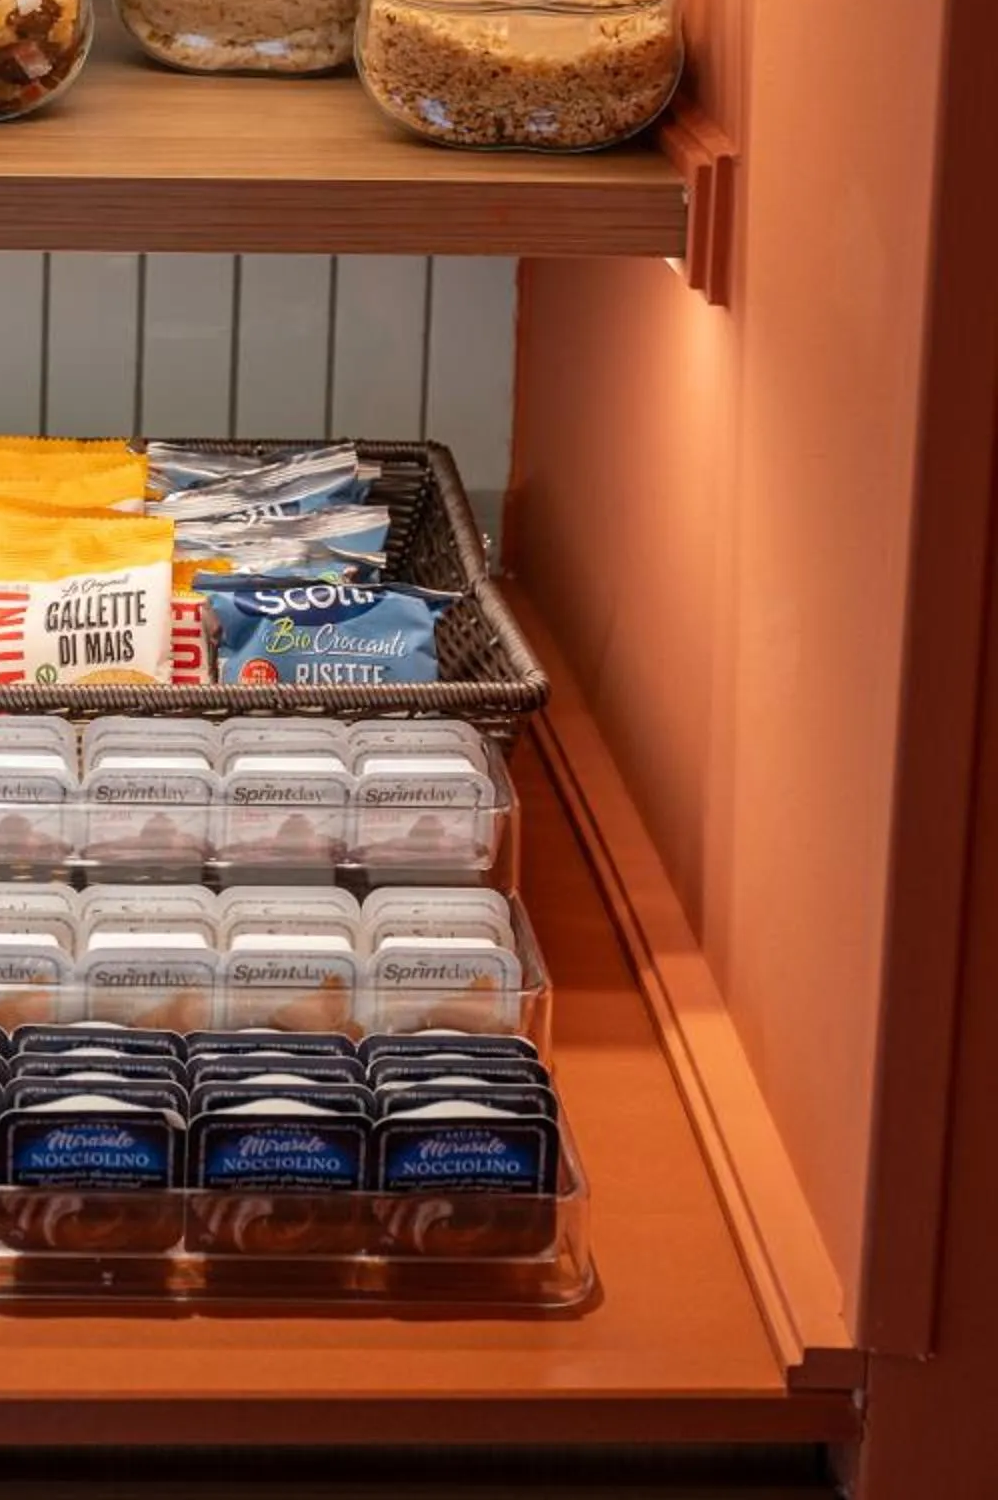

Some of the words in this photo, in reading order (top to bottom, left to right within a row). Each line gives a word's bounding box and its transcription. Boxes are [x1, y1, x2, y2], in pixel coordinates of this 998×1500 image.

[45, 590, 148, 632] GALLETTE
[266, 617, 311, 653] Bio
[59, 634, 77, 667] DI
[85, 629, 135, 666] MAIS
[295, 662, 386, 685] RISETTE
[45, 1129, 136, 1151] Mirasole
[238, 1135, 327, 1157] Mirasole
[419, 1137, 507, 1160] Mirasole
[30, 1152, 151, 1168] NOCCIOLINO
[222, 1157, 341, 1173] NOCCIOLINO
[403, 1159, 521, 1175] NOCCIOLINO
